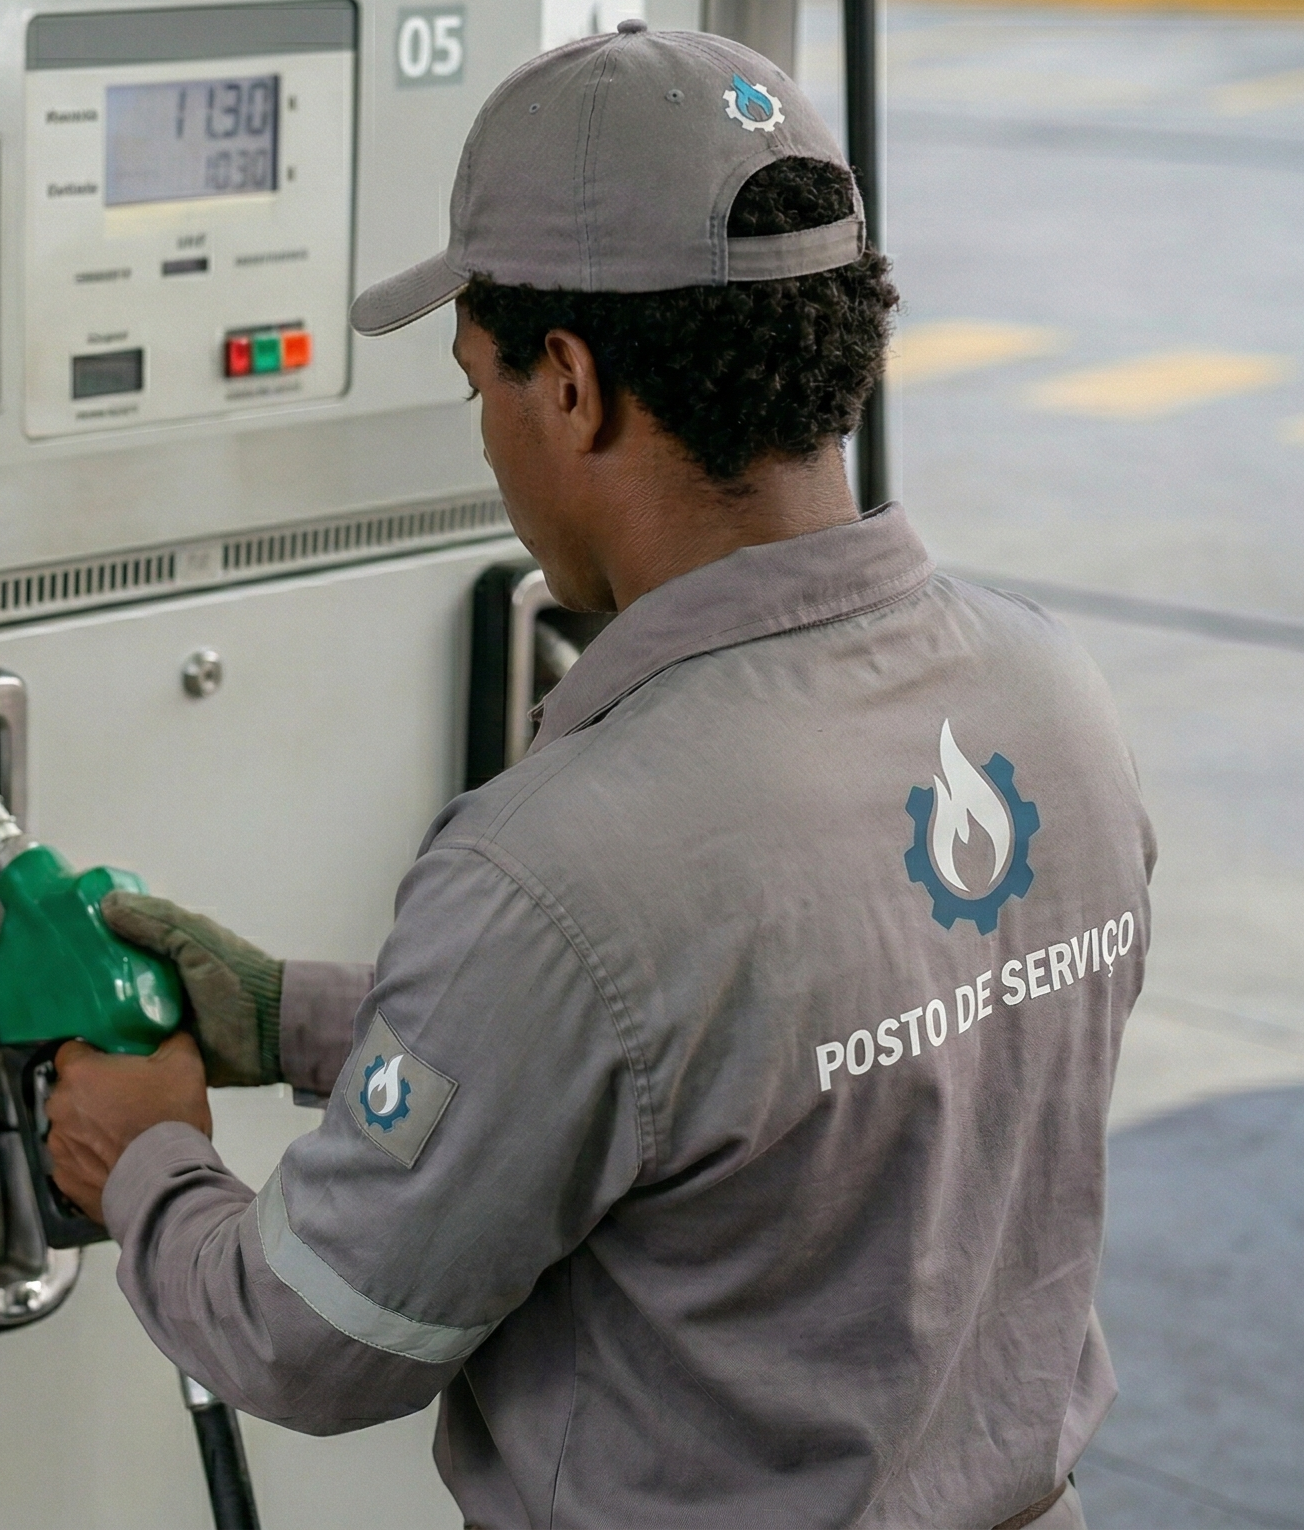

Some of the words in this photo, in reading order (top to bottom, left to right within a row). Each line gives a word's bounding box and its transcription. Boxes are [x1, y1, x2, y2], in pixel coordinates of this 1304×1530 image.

[398, 15, 464, 78] 05
[815, 998, 948, 1092] POSTO
[955, 969, 993, 1034] DE
[1000, 910, 1135, 1007] SERVIÇO
